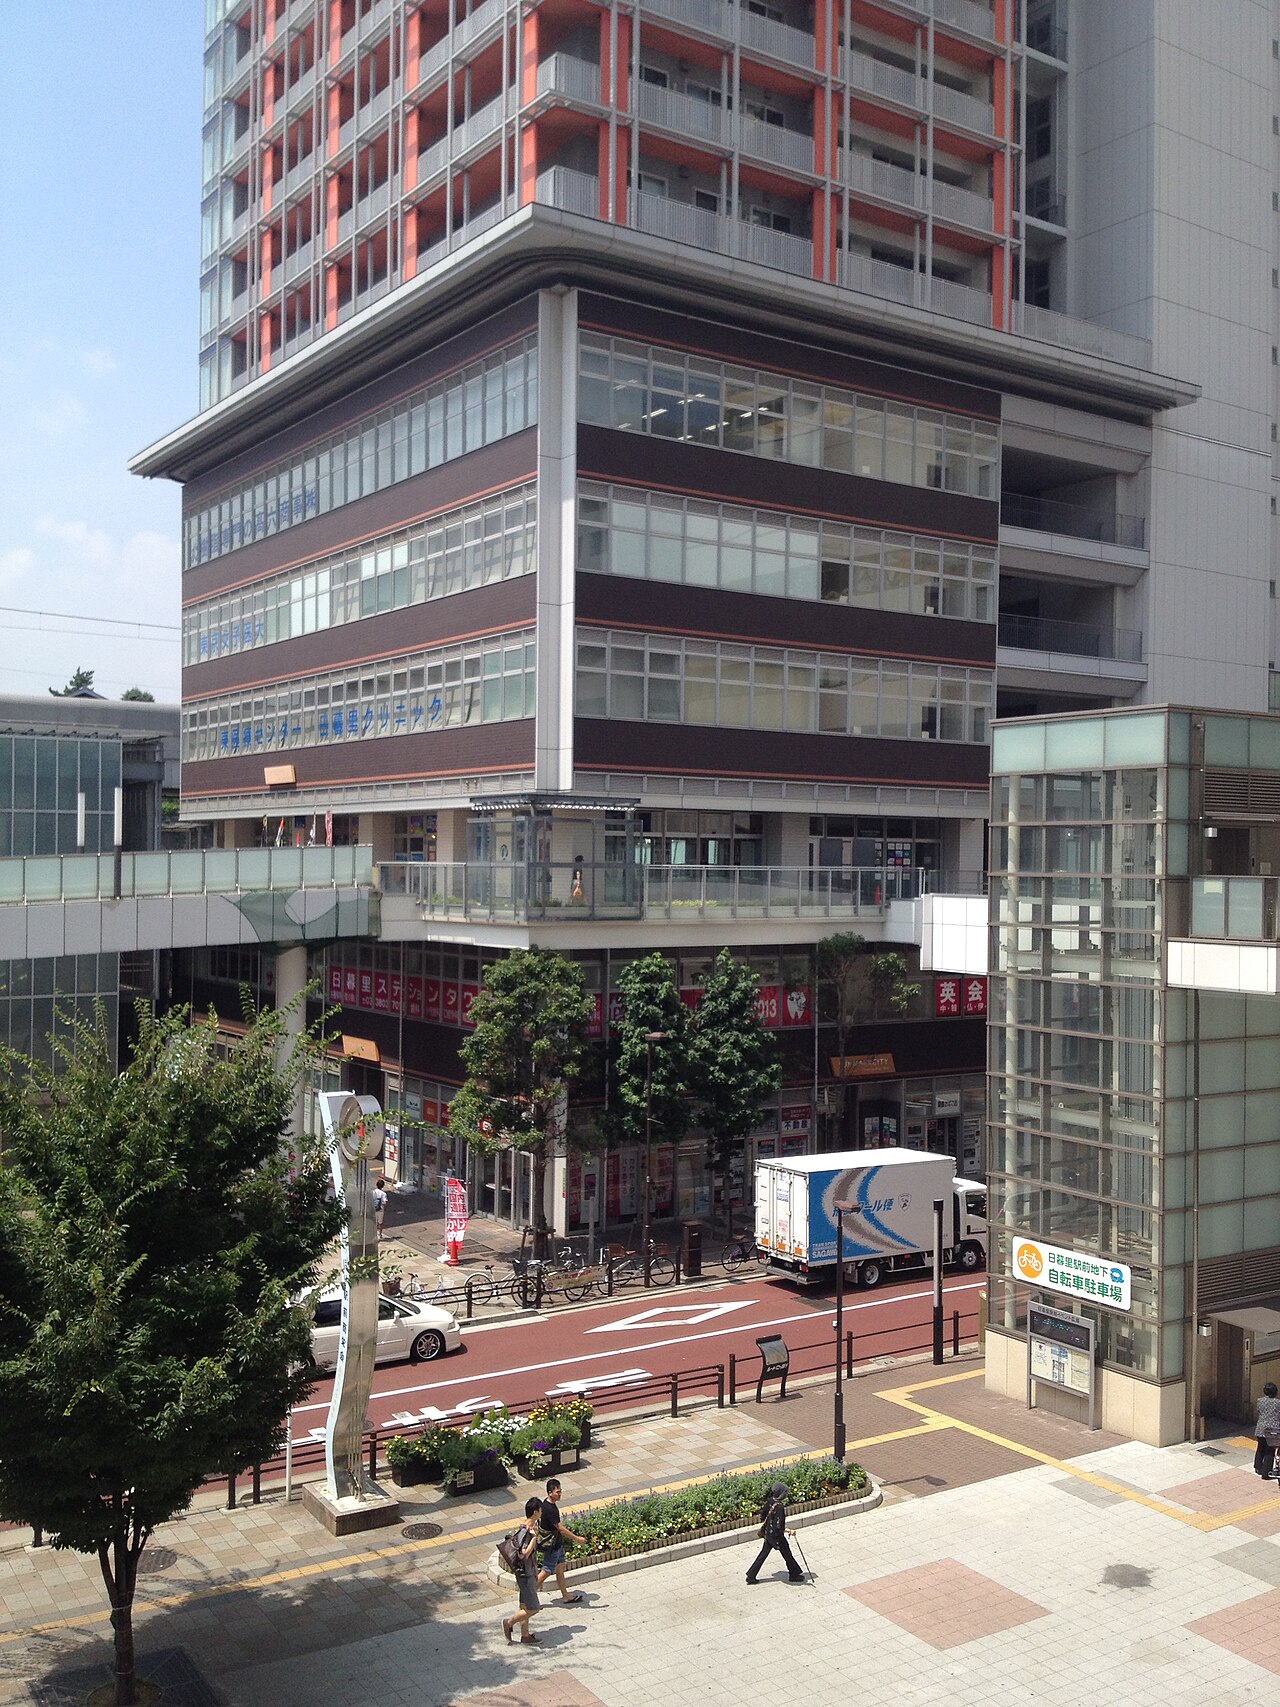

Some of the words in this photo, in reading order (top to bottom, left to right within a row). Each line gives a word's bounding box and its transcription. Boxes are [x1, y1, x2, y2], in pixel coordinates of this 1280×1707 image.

[319, 697, 441, 738] 日暮里クリニック
[1048, 1252, 1108, 1277] 日暮里駅前地下
[1047, 1269, 1122, 1302] 自転車駐車場
